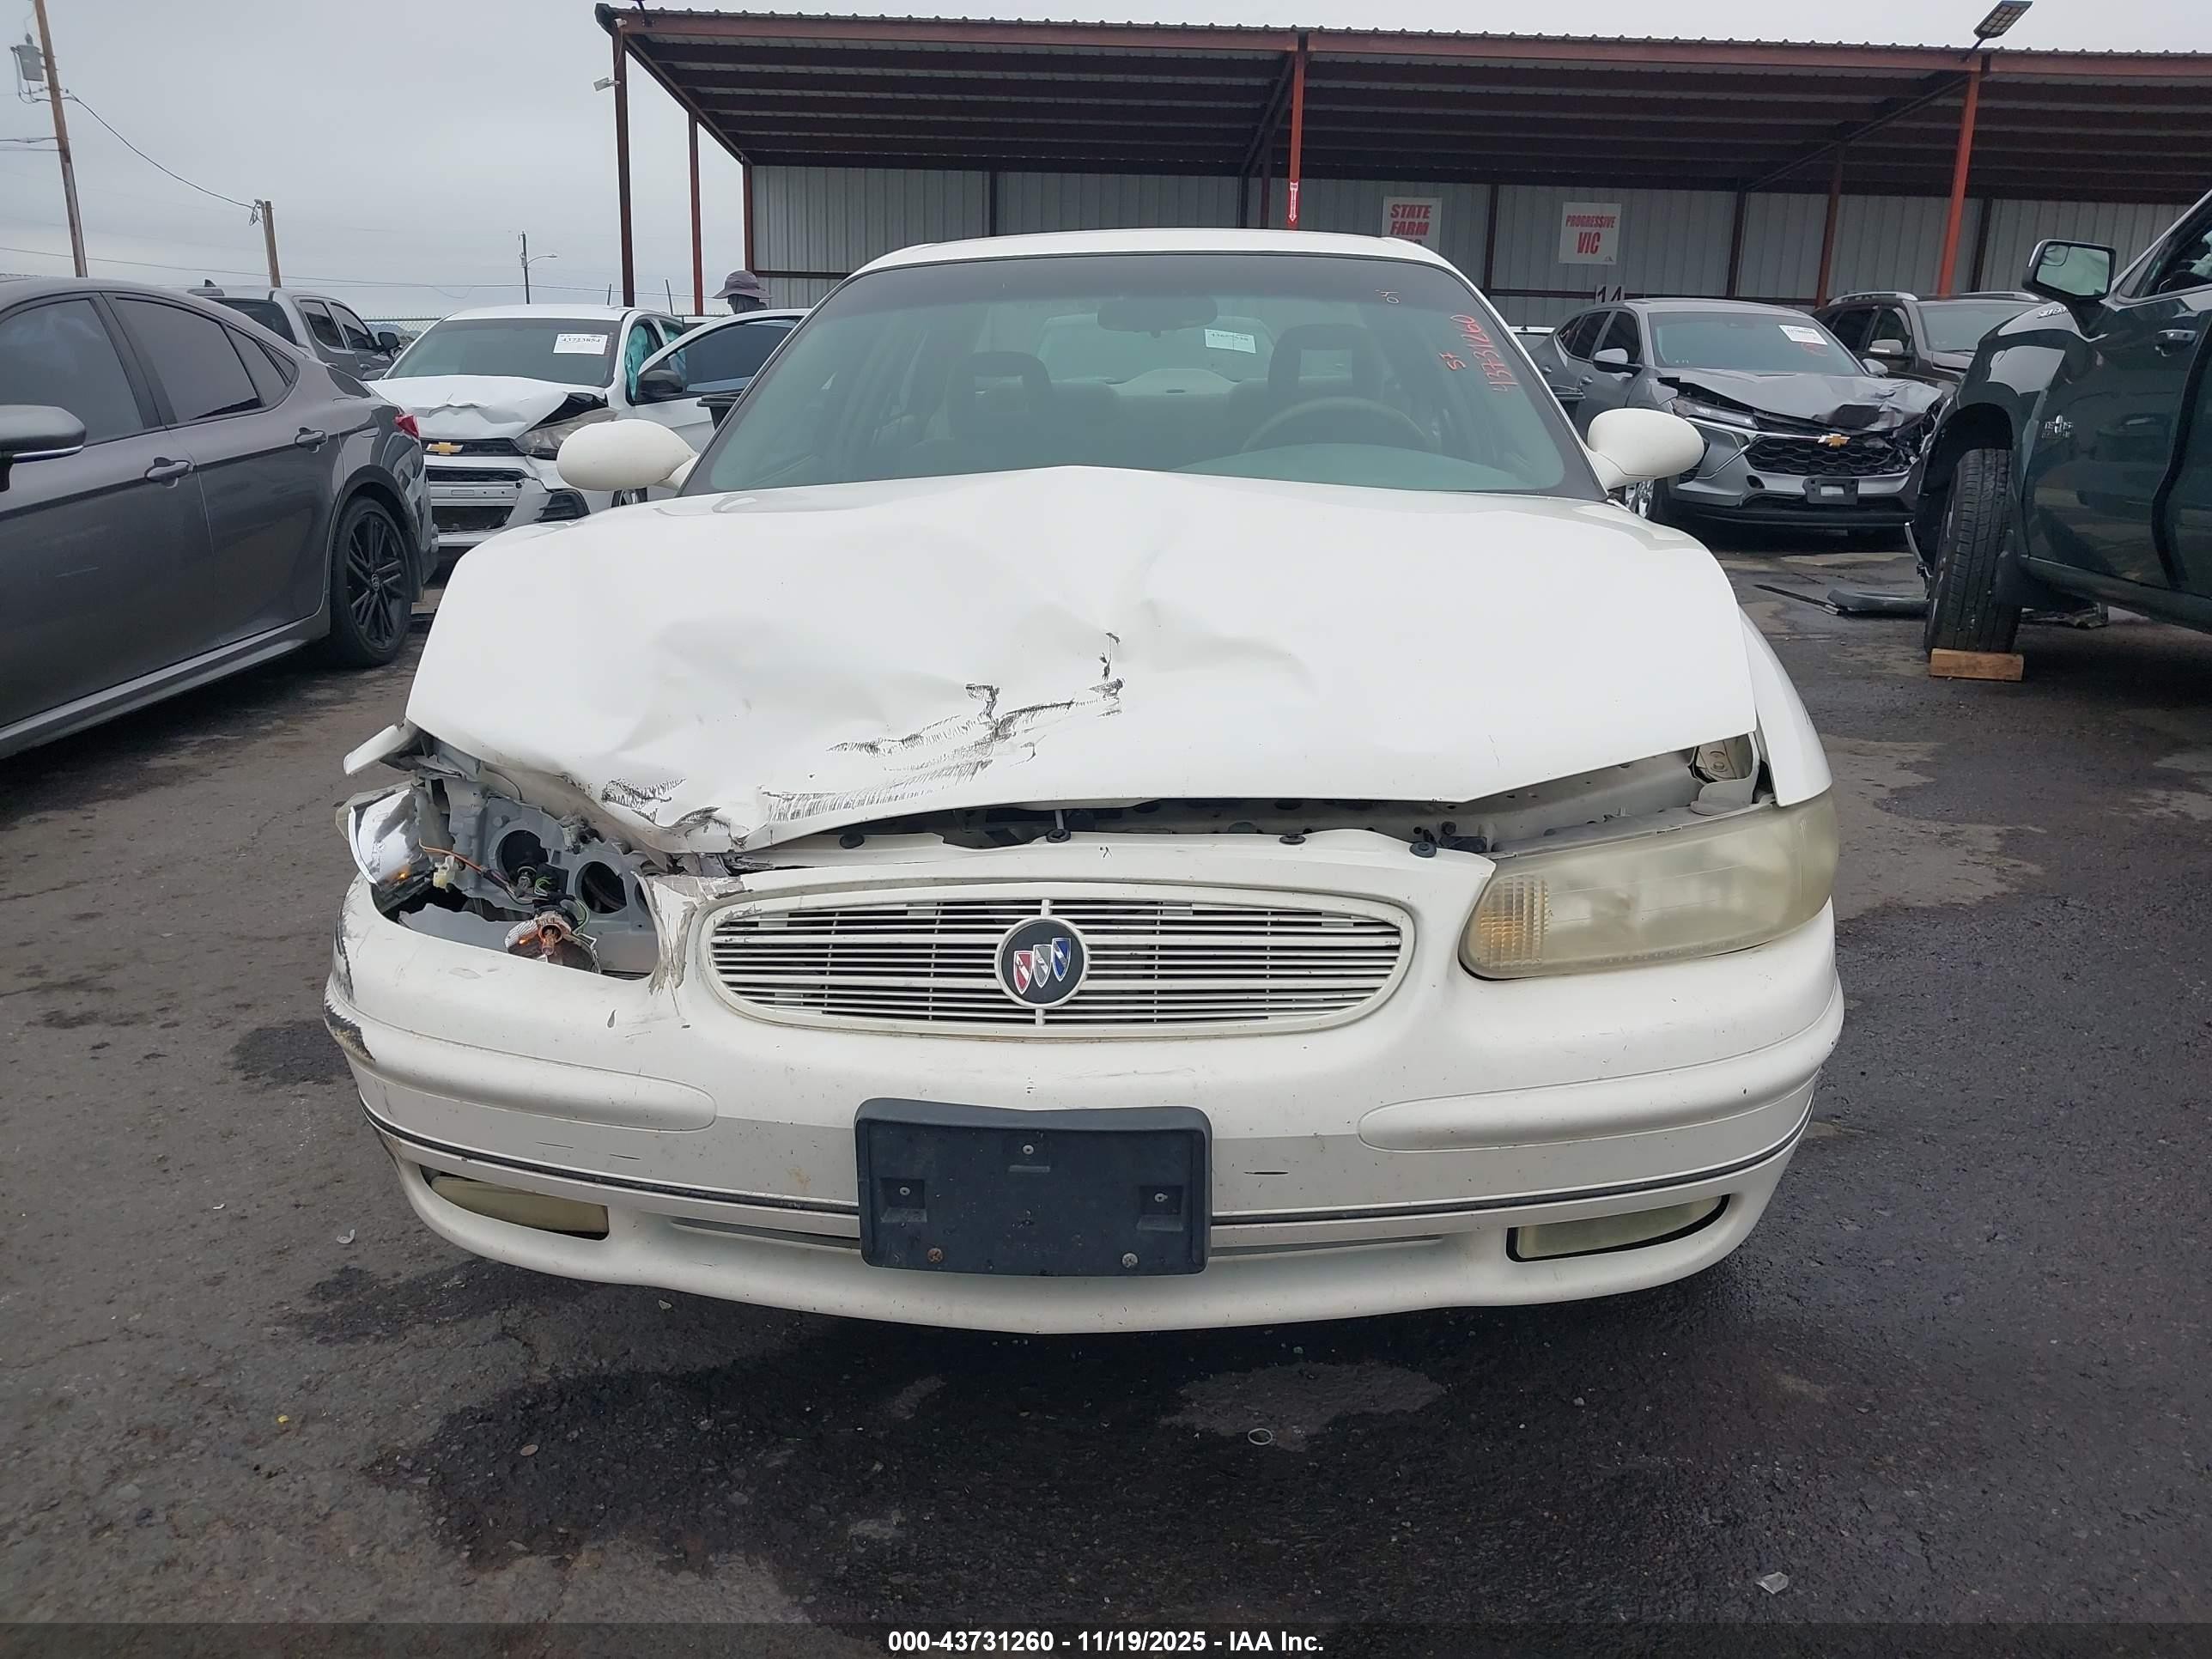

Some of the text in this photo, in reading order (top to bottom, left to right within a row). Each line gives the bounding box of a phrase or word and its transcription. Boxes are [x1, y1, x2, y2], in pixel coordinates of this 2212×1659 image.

[1390, 204, 1432, 219] STATE
[1390, 221, 1430, 235] FARM
[1565, 215, 1616, 228] PROGRESSIVE
[1577, 232, 1601, 254] VIC
